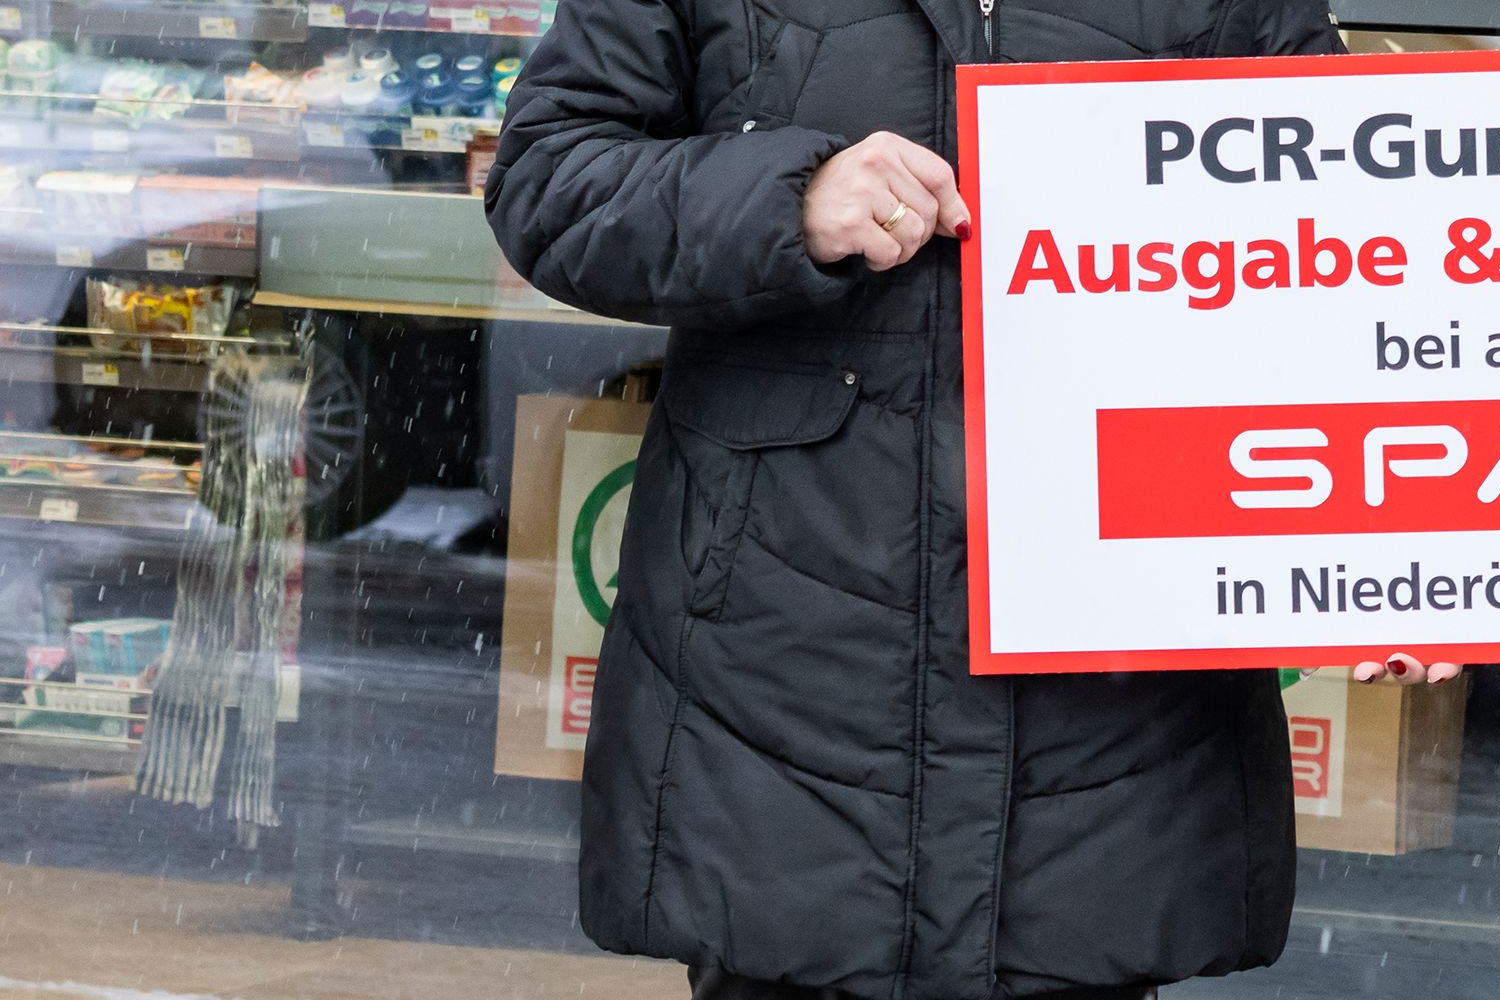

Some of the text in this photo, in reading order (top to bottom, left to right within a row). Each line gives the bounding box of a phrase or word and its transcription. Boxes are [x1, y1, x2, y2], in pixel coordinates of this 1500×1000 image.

[1006, 217, 1409, 311] Ausgabe
[1374, 320, 1462, 371] bei
[1215, 566, 1266, 616] in
